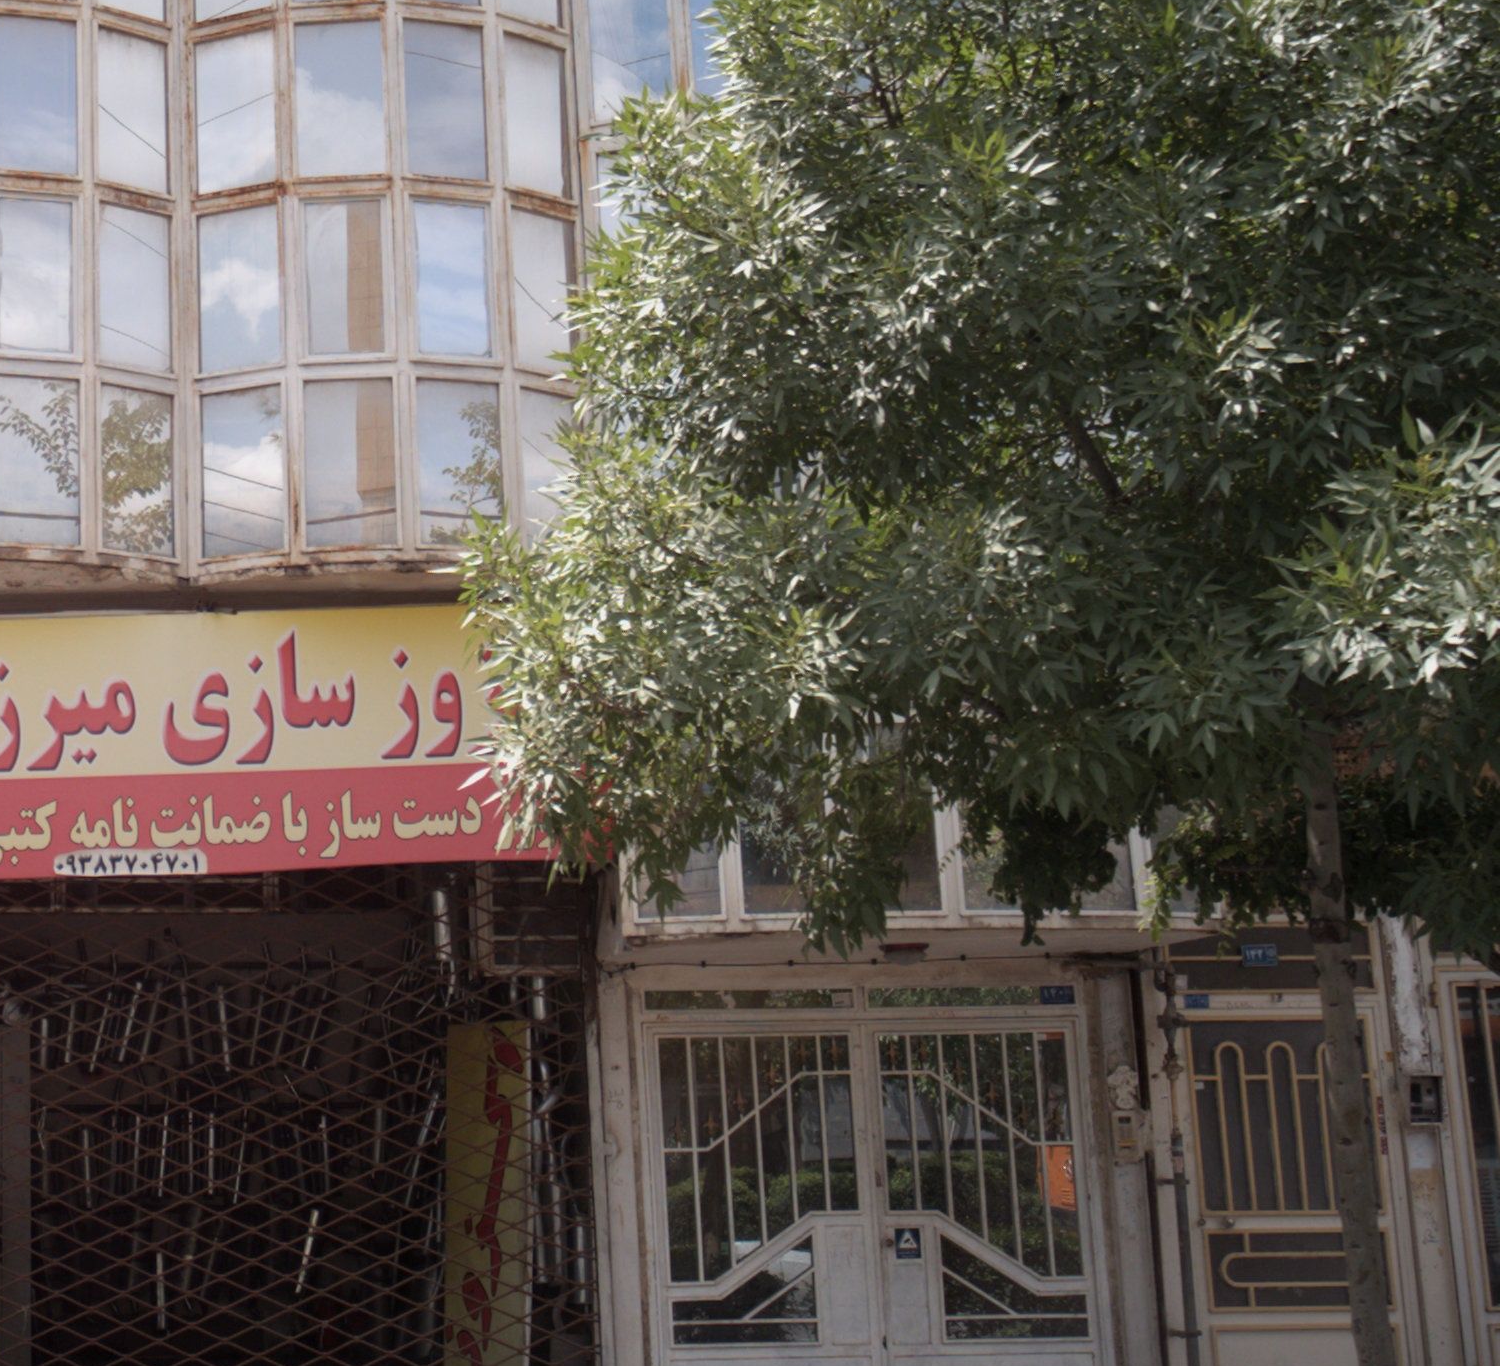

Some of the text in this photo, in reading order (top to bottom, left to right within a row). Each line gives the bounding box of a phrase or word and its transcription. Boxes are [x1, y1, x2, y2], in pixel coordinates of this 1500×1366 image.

[164, 631, 355, 765] سازی
[69, 796, 139, 848] نامه
[149, 794, 271, 849] ضمانت
[282, 791, 308, 856] با
[319, 789, 381, 858] ساز
[393, 795, 482, 839] دست
[55, 854, 199, 875] ۰۹۳۸۳۷۰۴۷۰۱
